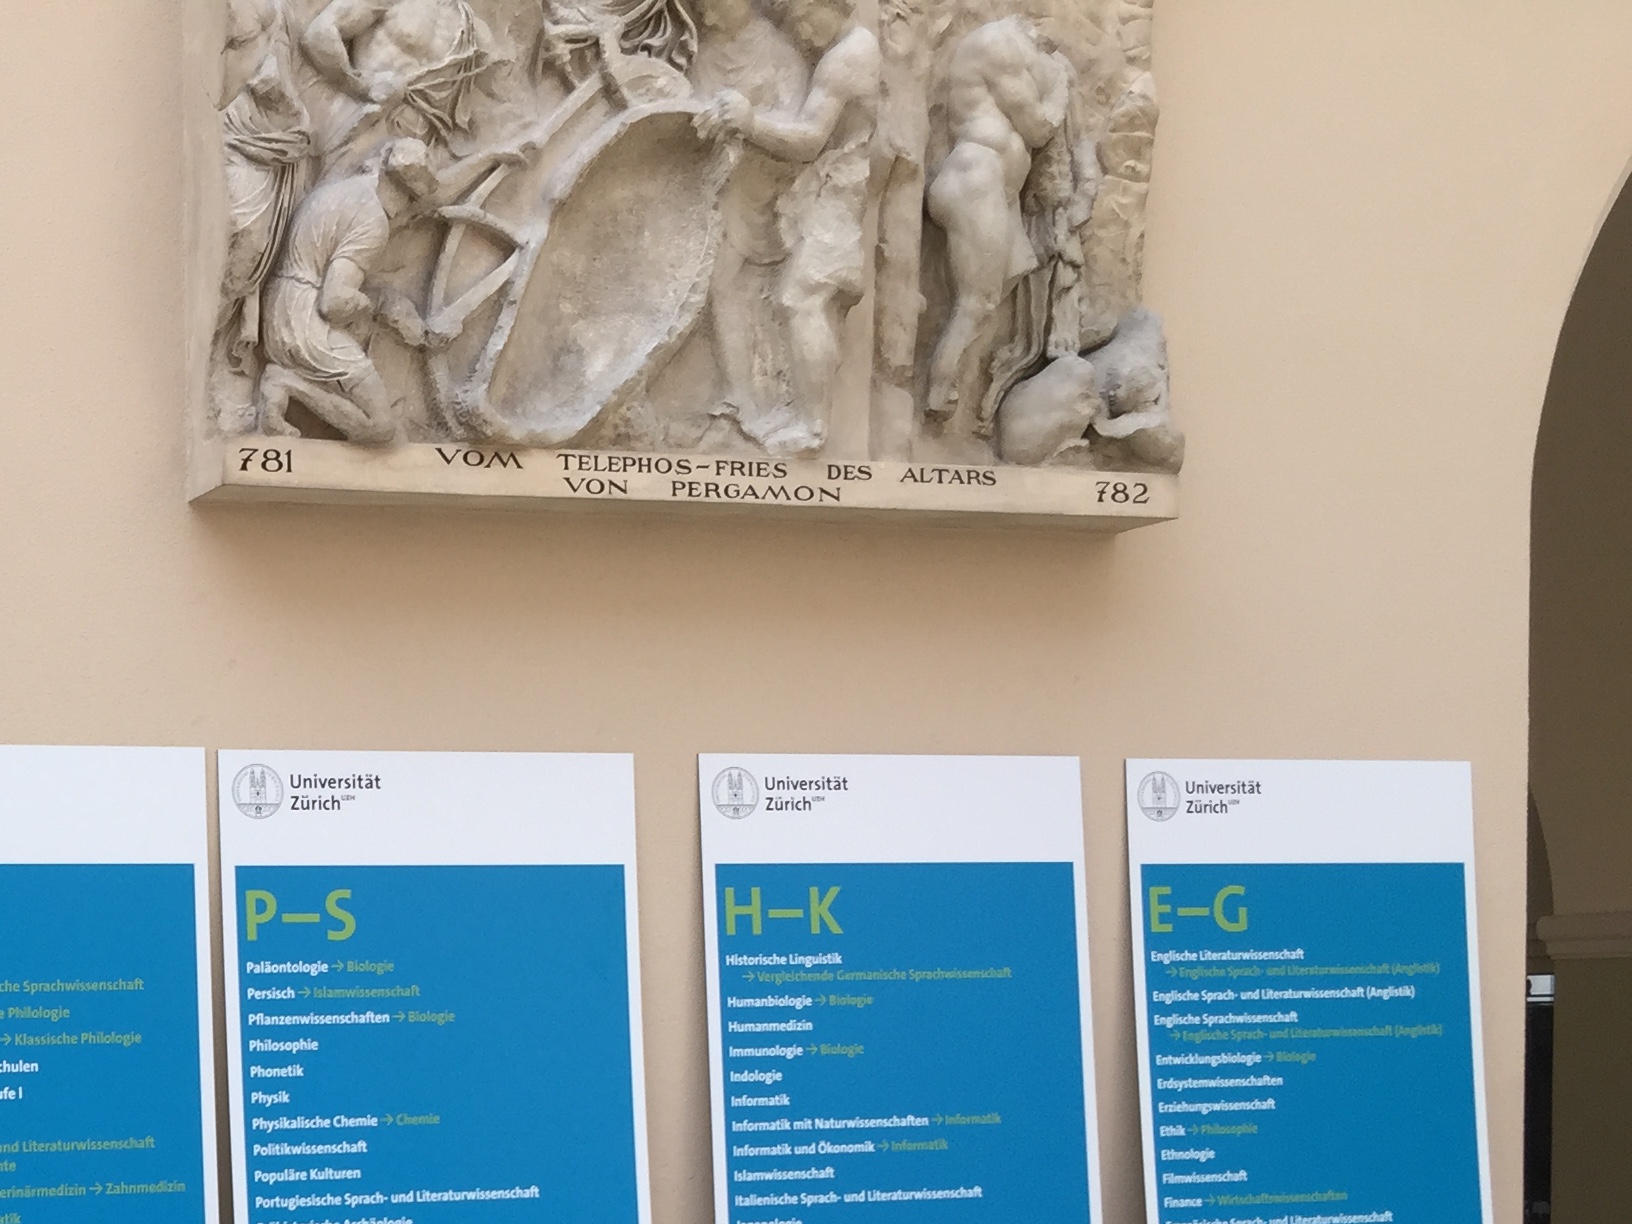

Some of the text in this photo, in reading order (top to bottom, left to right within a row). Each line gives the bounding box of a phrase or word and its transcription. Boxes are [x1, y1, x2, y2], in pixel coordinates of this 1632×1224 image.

[238, 447, 292, 473] 781
[435, 446, 523, 469] VOM
[556, 453, 996, 486] TELEPHOS-FRIES DES ALTARS
[563, 477, 840, 502] VON PERGAMON
[1095, 481, 1149, 504] 782
[290, 773, 381, 789] Universität
[764, 776, 848, 791] Universität
[1185, 780, 1261, 794] Universität
[725, 952, 842, 968] Historische Linguistik
[1150, 947, 1304, 964] Englische Literaturwissenschaft
[246, 960, 329, 976] Paläontologie
[247, 986, 295, 1000] Persisch
[248, 1010, 390, 1025] Pflanzenwissenschaften
[728, 1019, 813, 1032] Humanmedizin
[249, 1038, 319, 1054] Philosophie
[250, 1064, 304, 1077] Phonetik
[730, 1069, 782, 1085] Indologie
[251, 1090, 290, 1107] Physik
[1158, 1097, 1276, 1115] Erziehungswissenschaft
[252, 1114, 378, 1133] Physikalische Chemie
[253, 1139, 368, 1156] Politikwissenschaft
[1160, 1147, 1215, 1162] Ethnologie
[254, 1167, 361, 1185] Populäre Kulturen
[733, 1166, 835, 1182] Islamwissenschaft
[1162, 1169, 1248, 1184] Filmwissenschaft
